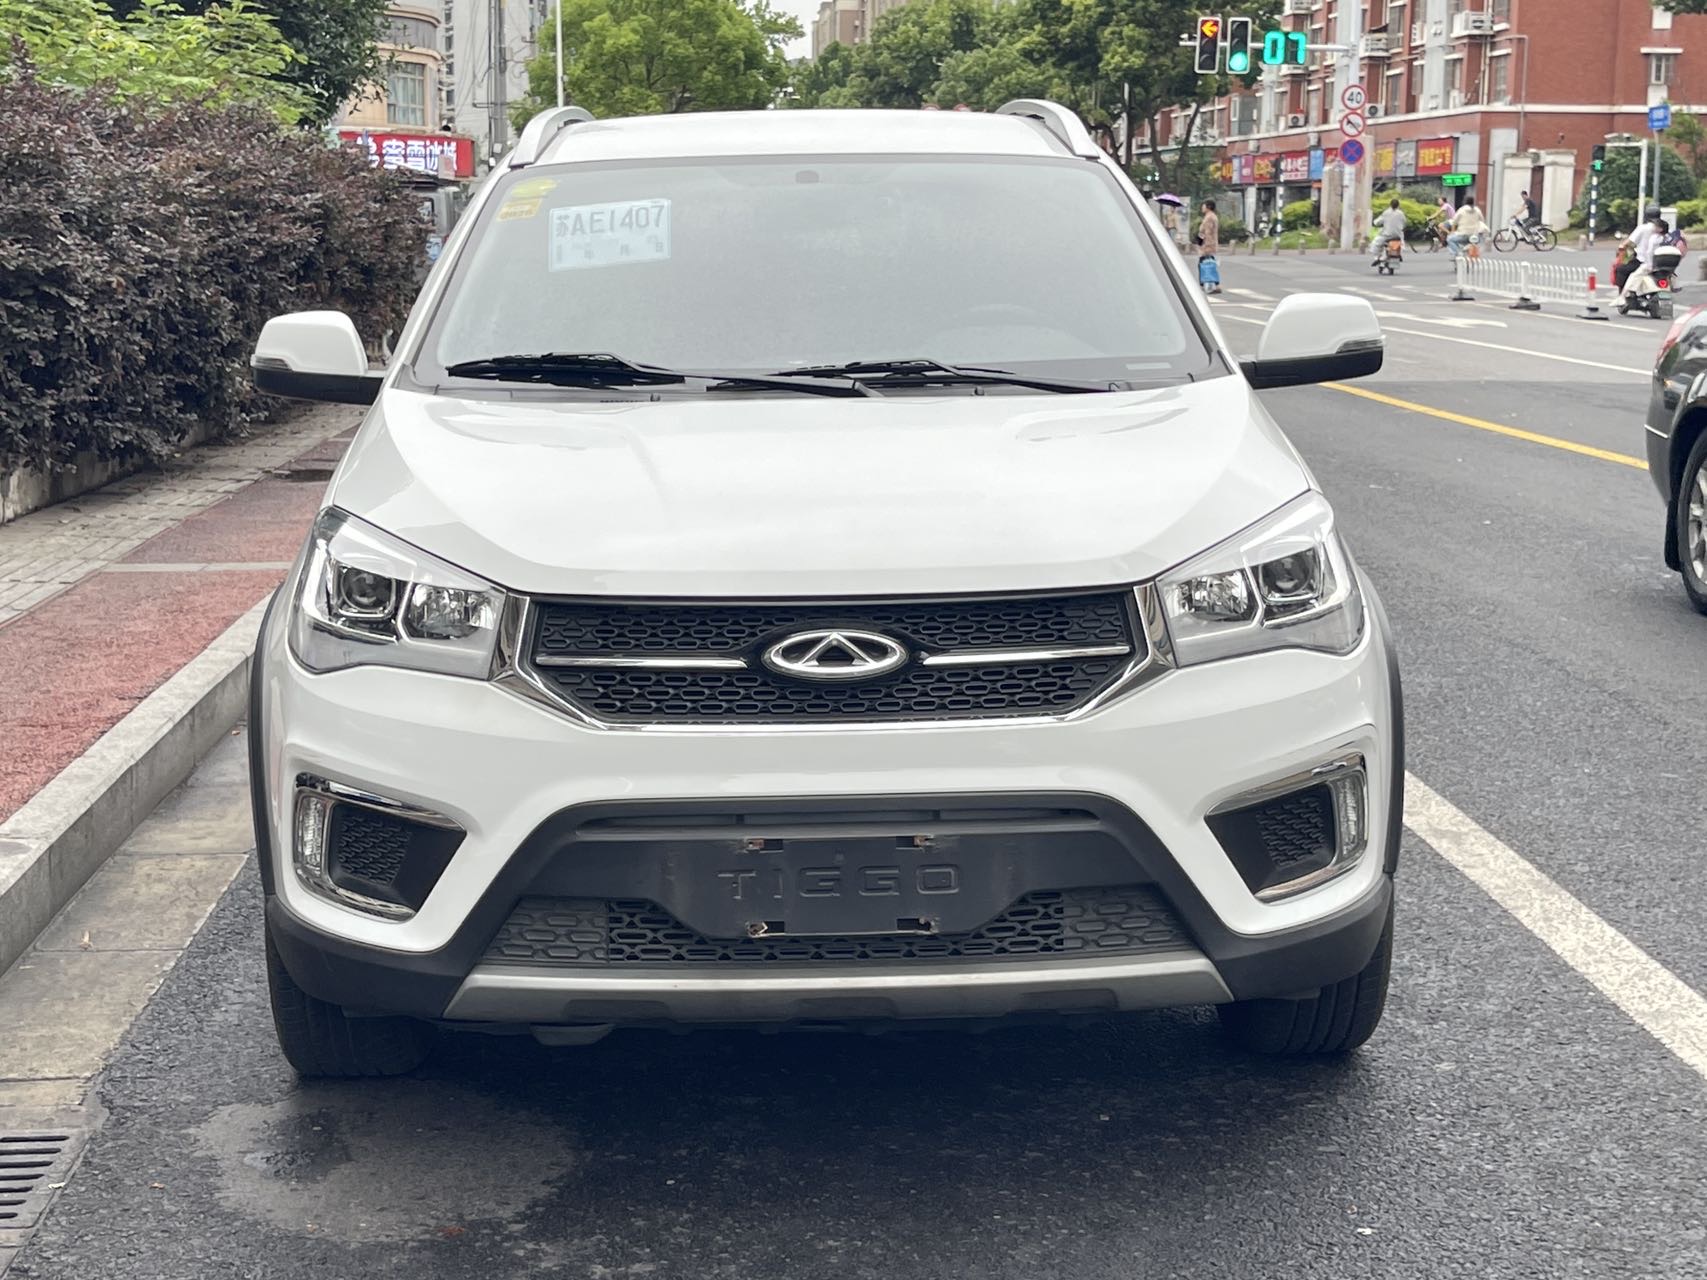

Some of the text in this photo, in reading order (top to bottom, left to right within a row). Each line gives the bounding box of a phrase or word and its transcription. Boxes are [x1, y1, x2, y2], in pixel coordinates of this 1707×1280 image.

[1263, 30, 1306, 65] 07
[1347, 91, 1363, 104] 40
[717, 864, 960, 900] TIGGO
